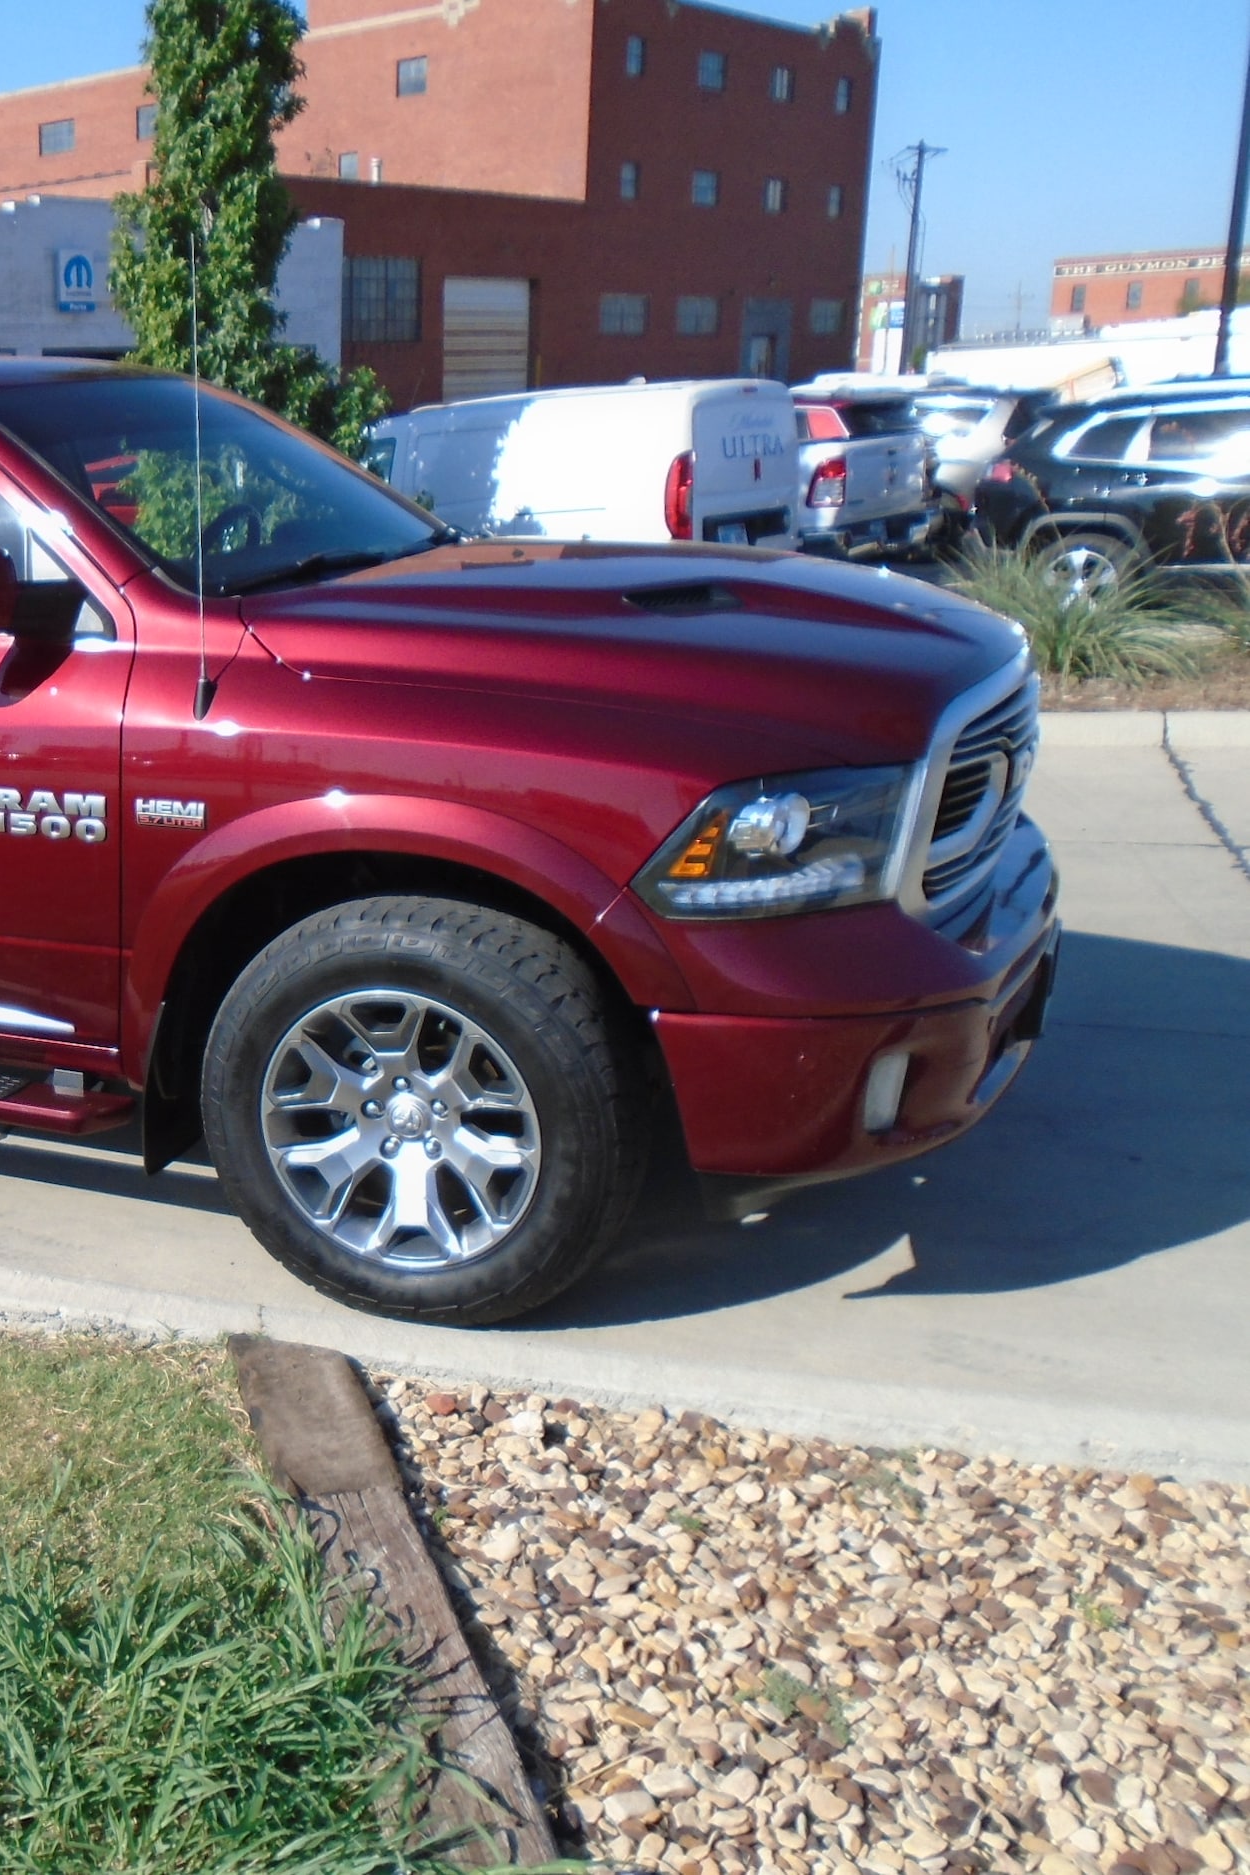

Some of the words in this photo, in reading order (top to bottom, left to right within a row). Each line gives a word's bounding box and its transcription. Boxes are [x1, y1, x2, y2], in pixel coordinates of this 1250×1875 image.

[1061, 264, 1097, 275] THE
[1104, 259, 1190, 273] GUYMON
[722, 433, 784, 458] ULTRA
[136, 799, 206, 818] HEMI
[138, 814, 161, 825] 5.7
[162, 816, 204, 828] LITER
